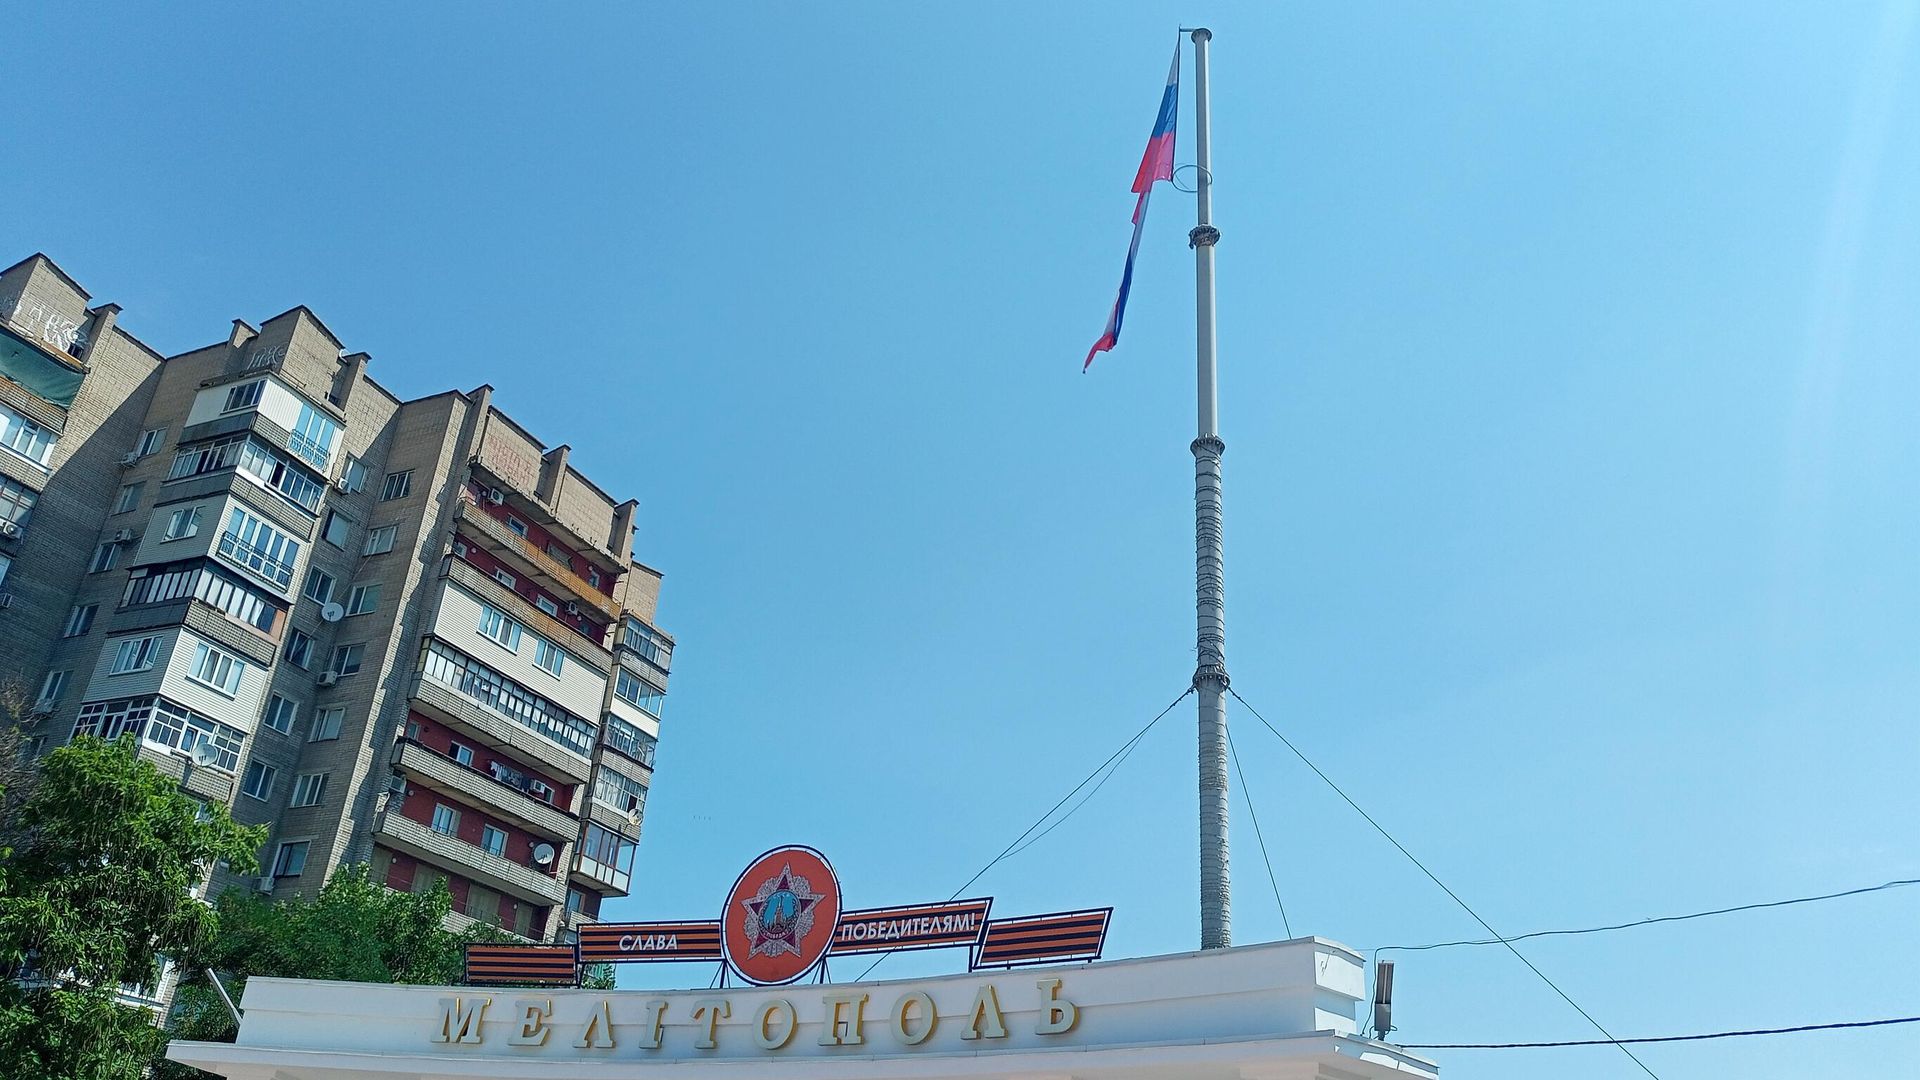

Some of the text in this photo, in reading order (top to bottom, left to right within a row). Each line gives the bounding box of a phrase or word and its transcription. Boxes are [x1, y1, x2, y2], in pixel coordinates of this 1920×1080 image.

[619, 912, 976, 951] СЛАВА ПОБЕДИТЕЛЯМ!
[430, 978, 1080, 1050] МЕЛІТОПОЛЬ
